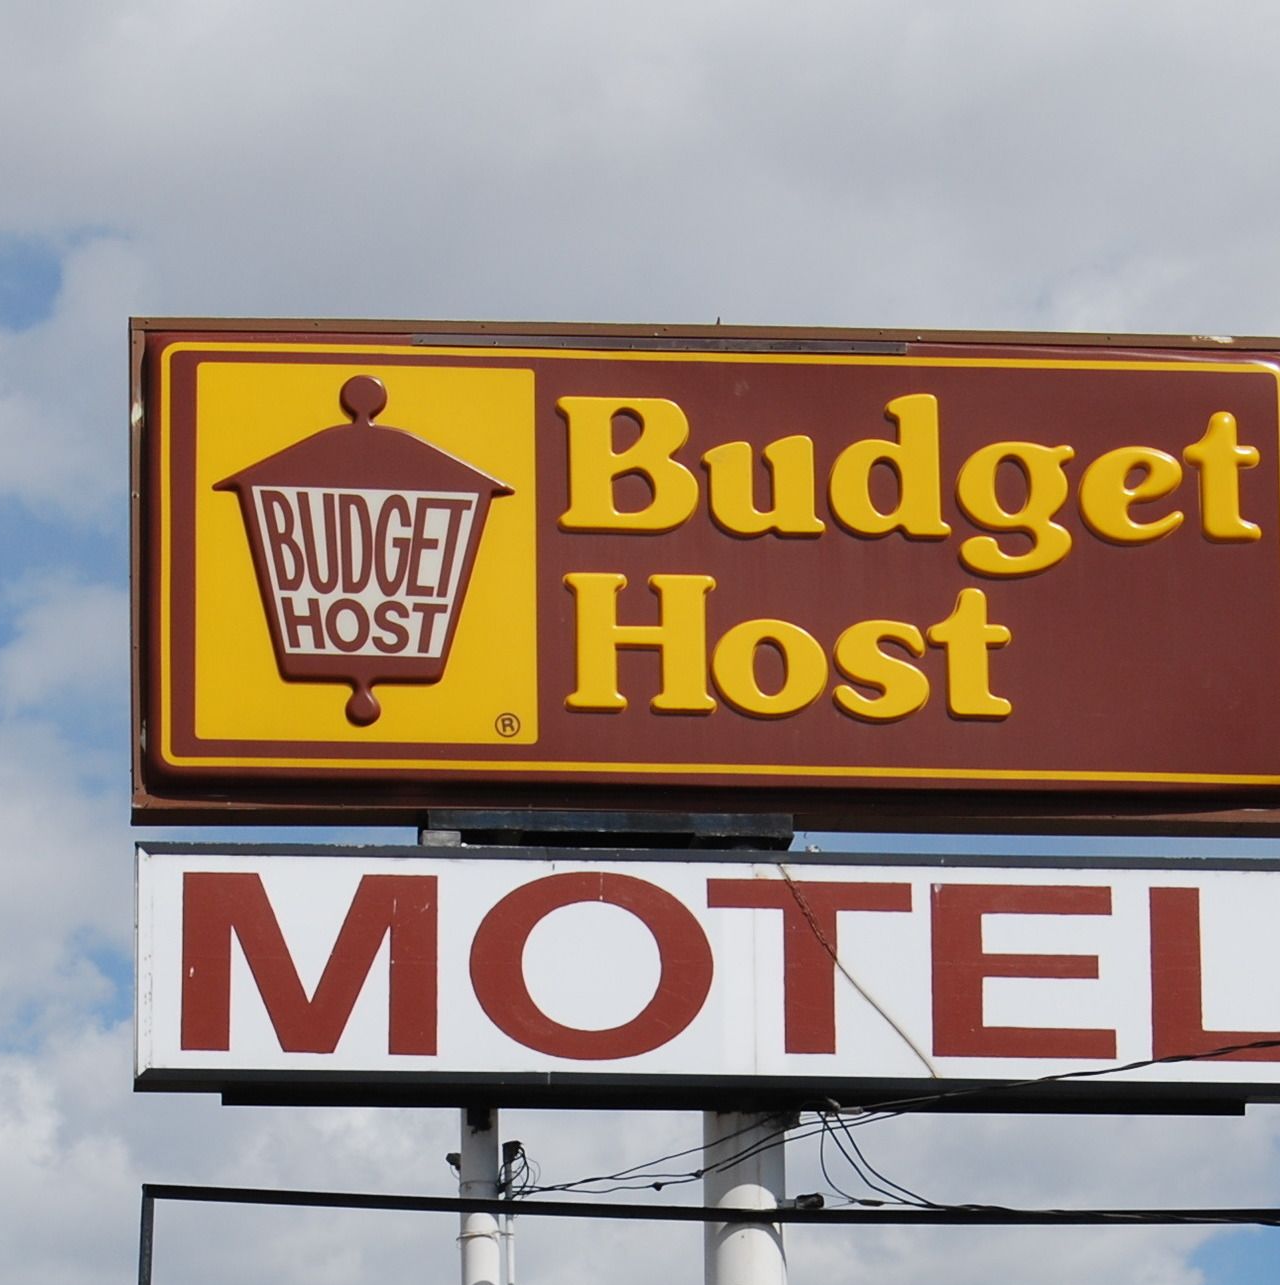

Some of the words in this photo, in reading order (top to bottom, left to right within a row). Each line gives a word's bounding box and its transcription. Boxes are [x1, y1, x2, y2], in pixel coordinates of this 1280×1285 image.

[260, 489, 473, 598] BUDGET
[557, 393, 1263, 577] Budget
[280, 597, 449, 654] HOST
[564, 572, 1013, 721] Host
